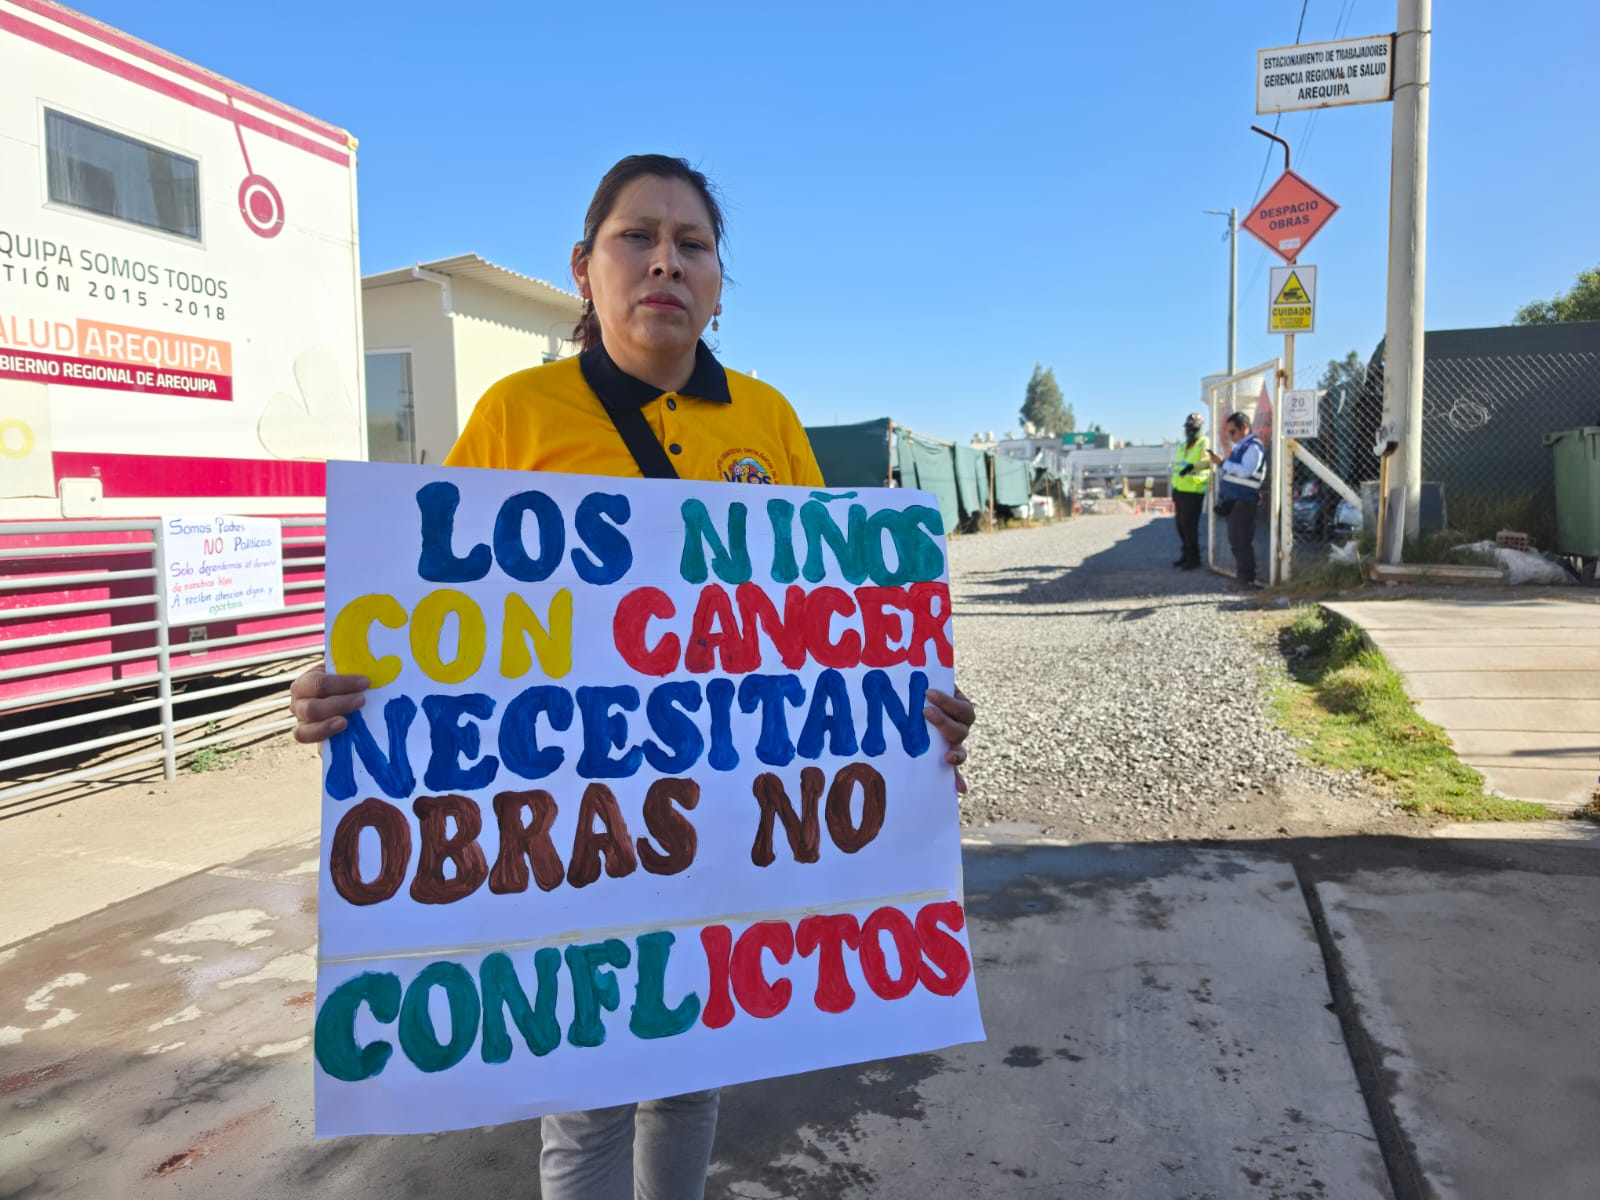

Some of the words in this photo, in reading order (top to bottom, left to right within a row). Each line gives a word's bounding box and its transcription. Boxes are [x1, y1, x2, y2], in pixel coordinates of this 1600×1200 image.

[1264, 52, 1324, 69] ESTACIONAMIENTO
[1325, 50, 1334, 63] DE
[1336, 44, 1388, 60] TRABAJADORES
[1264, 71, 1303, 87] GERENCIA
[1305, 67, 1345, 83] REGIONAL
[1347, 65, 1357, 78] DE
[1360, 62, 1386, 76] SALUD
[1298, 83, 1350, 100] AREQUIPA
[1259, 200, 1319, 219] DESPACIO
[1269, 214, 1310, 231] OBRAS
[80, 249, 159, 285] SOMOS
[164, 268, 228, 299] TODOS
[88, 281, 147, 306] 2015
[1272, 305, 1311, 317] CUIDADO
[84, 327, 222, 372] AREQUIPA
[63, 361, 134, 384] REGIONAL
[136, 371, 154, 386] DE
[156, 374, 217, 393] AREQUIPA
[1291, 397, 1305, 408] 20
[169, 518, 212, 535] Somos
[215, 517, 245, 533] Padres
[416, 480, 633, 585] LOS
[680, 490, 945, 588] NIÑOS
[204, 537, 224, 555] NO
[234, 536, 272, 552] Politicos
[170, 562, 194, 577] Solo
[171, 593, 180, 608] A
[330, 588, 573, 689] CON
[612, 582, 953, 677] CANCER
[325, 668, 931, 800] NECESITAN
[330, 777, 700, 906] OBRAS
[751, 762, 886, 867] NO
[314, 901, 971, 1082] CONFLICTOS
